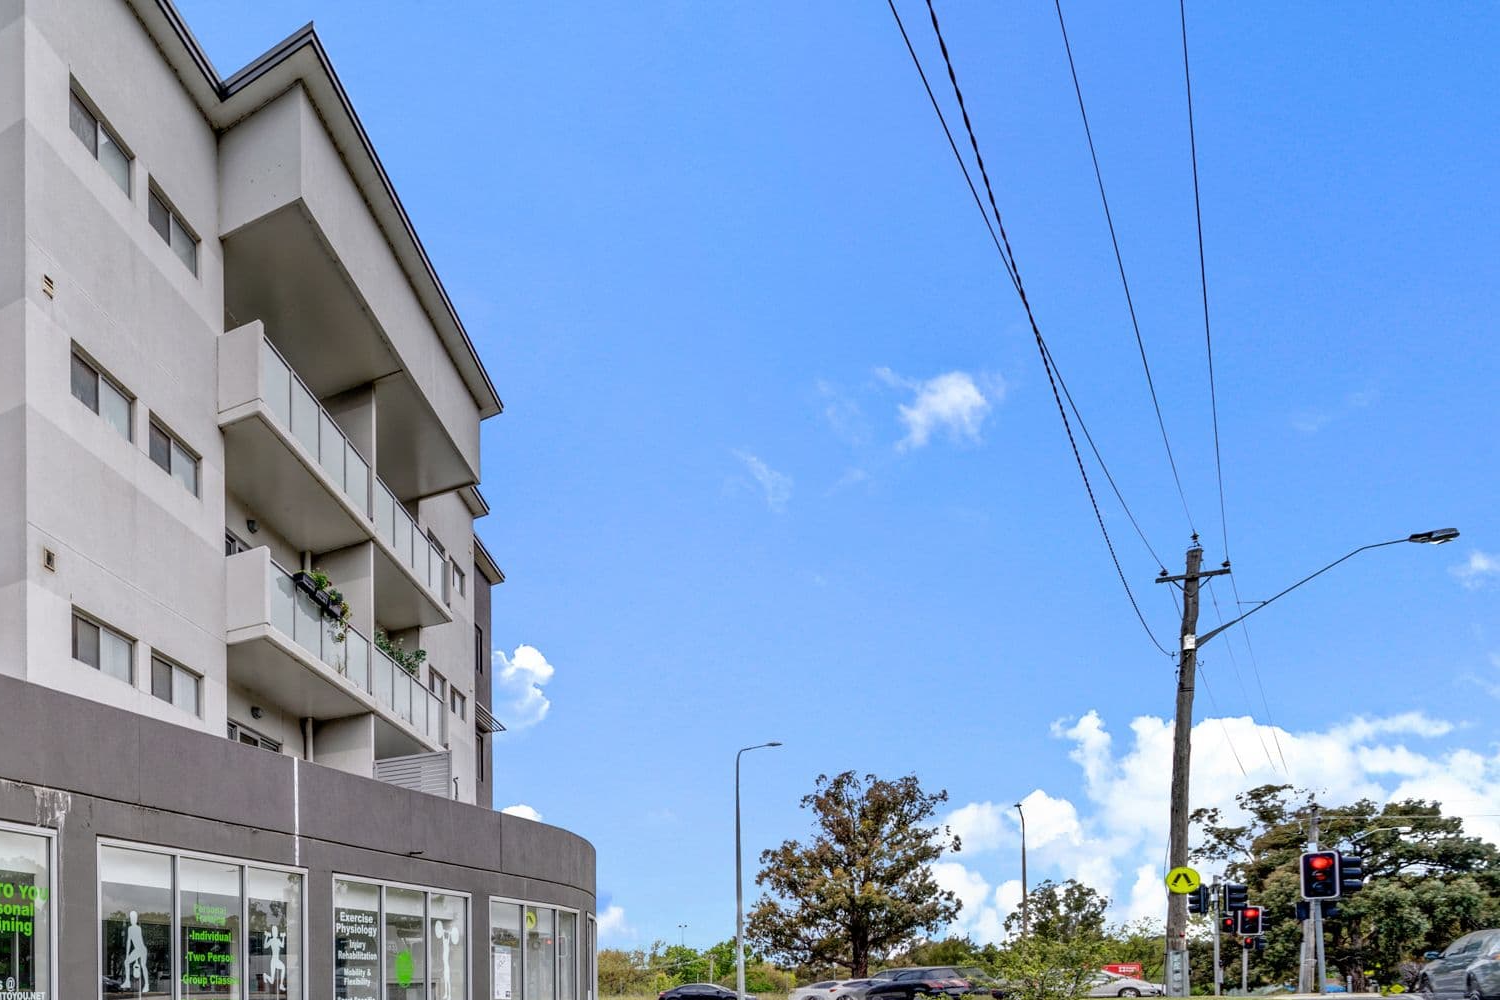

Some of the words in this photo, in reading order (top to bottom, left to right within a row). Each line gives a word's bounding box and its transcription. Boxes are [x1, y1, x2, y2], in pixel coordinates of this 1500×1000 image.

[19, 884, 49, 902] YOU
[340, 911, 373, 924] Exercise
[336, 922, 377, 937] Physiology
[337, 950, 378, 960] Rehabilitation
[6, 976, 16, 992] @
